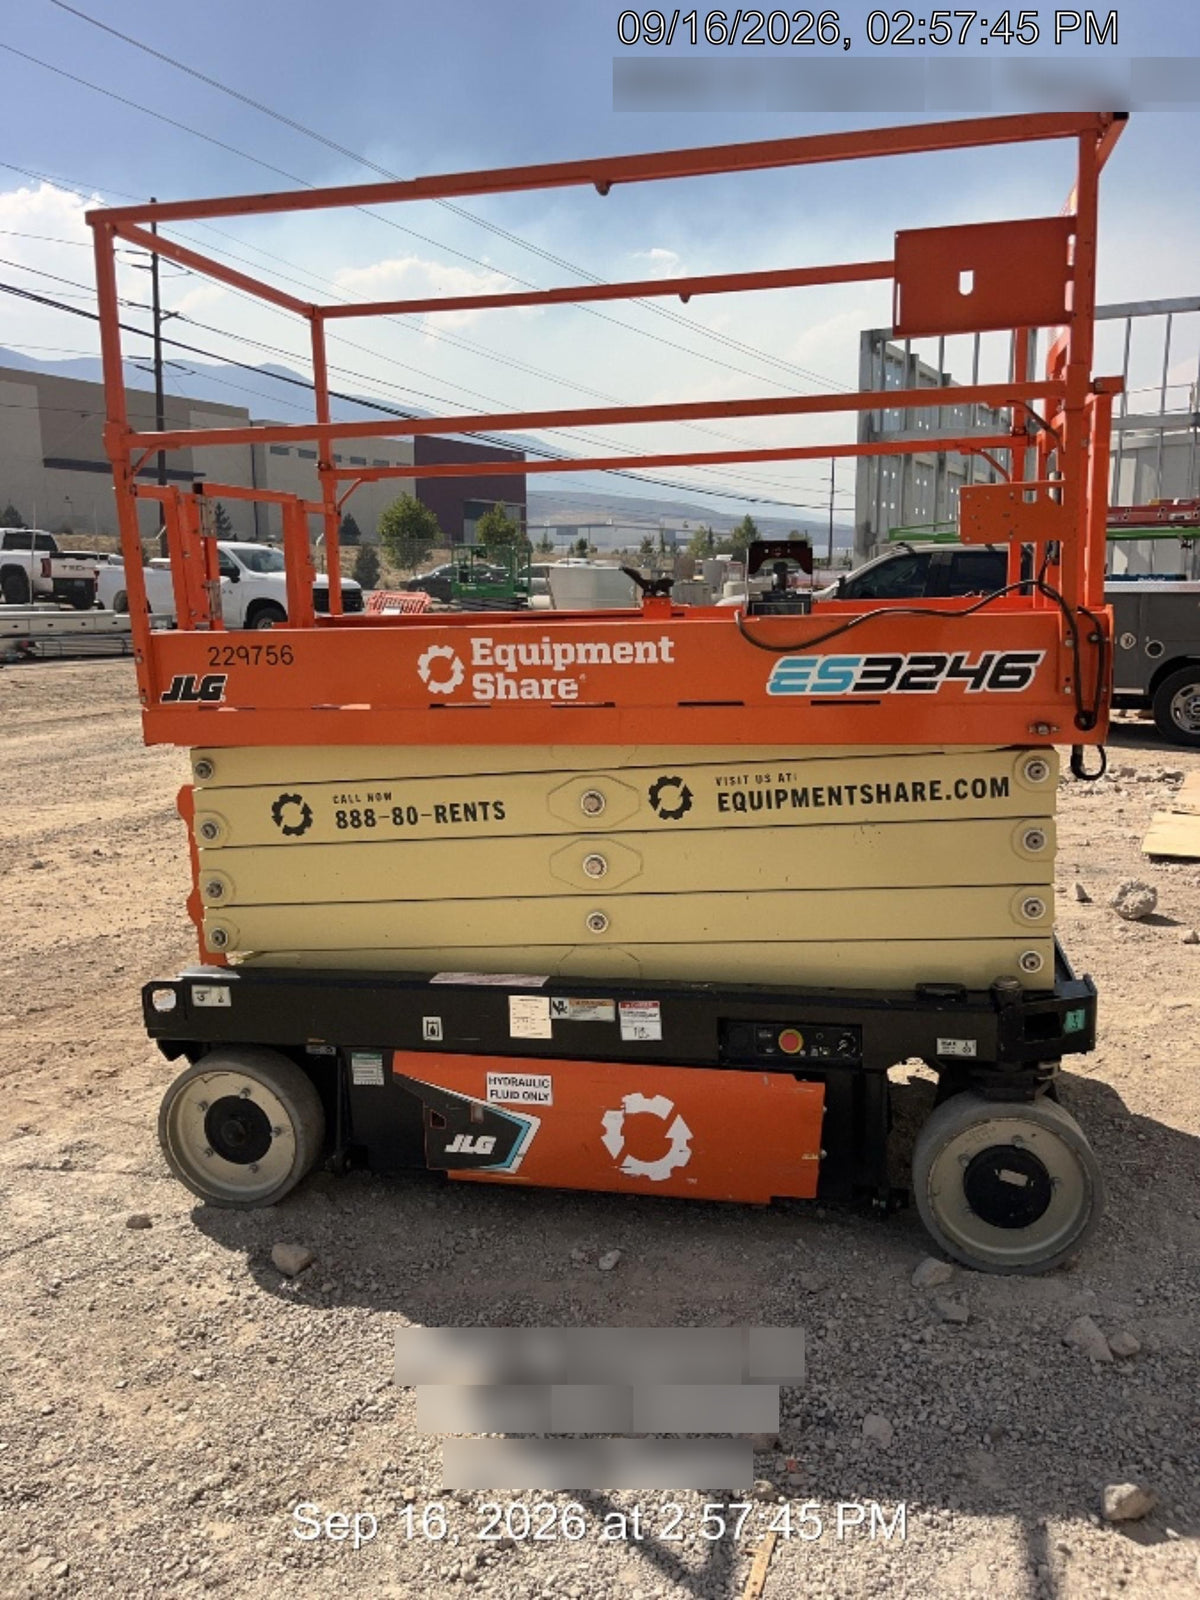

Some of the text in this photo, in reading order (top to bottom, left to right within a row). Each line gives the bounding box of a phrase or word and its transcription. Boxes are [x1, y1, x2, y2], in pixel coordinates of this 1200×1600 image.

[207, 644, 294, 667] 229756
[470, 636, 675, 672] Equipment
[766, 650, 1047, 695] ES3246
[160, 674, 228, 703] JLG
[472, 672, 579, 700] Share
[715, 774, 749, 786] VISIT
[755, 773, 771, 784] US
[332, 791, 392, 804] CALL NOW
[717, 777, 1010, 813] EQUIPMENTSHARE.COM
[335, 801, 506, 829] 888-80-RENTS
[488, 1076, 550, 1089] HYDRAULIC
[490, 1089, 550, 1102] FLUID ONLY
[444, 1134, 497, 1154] JLG
